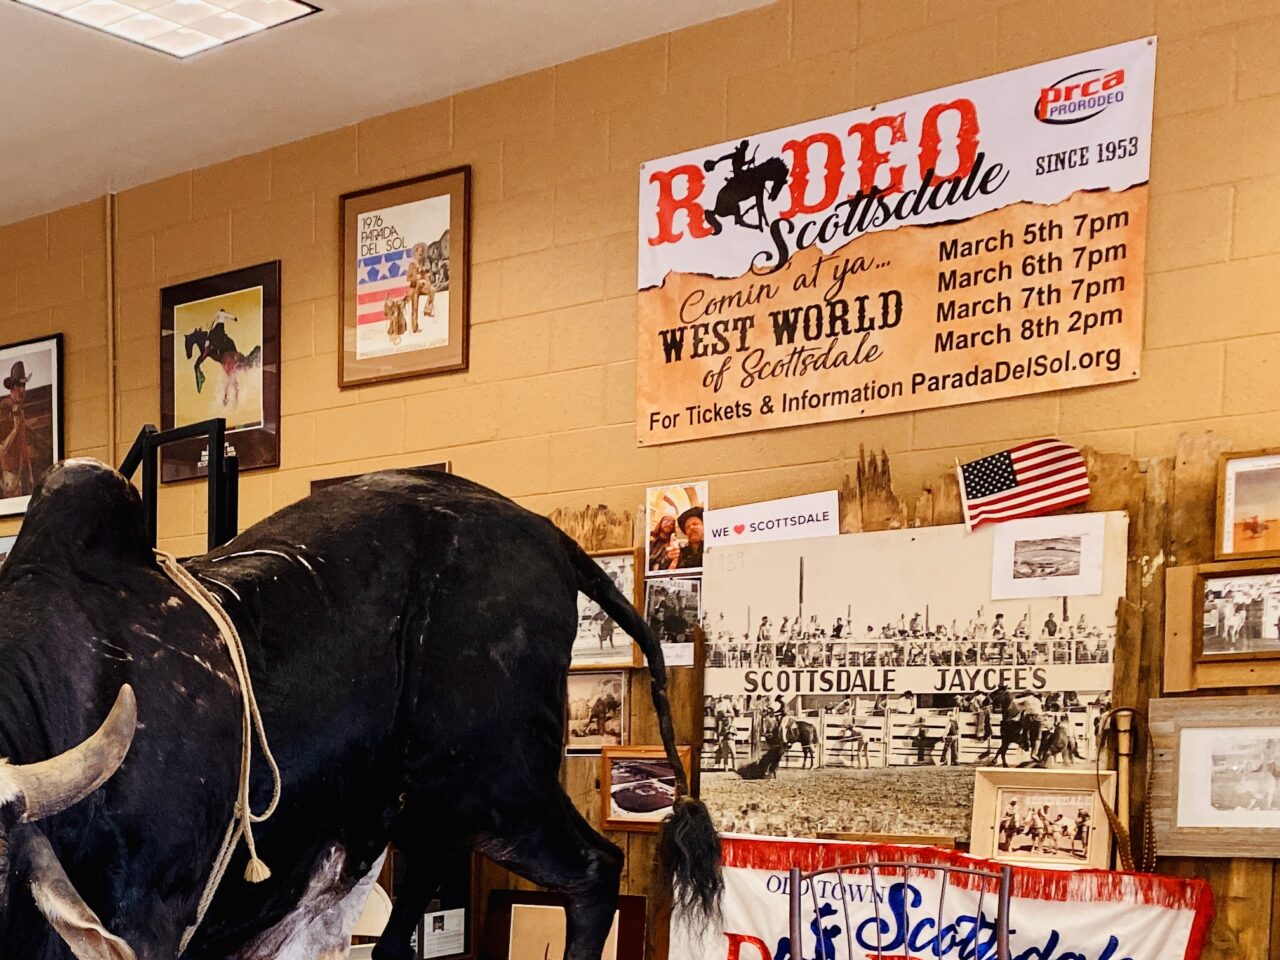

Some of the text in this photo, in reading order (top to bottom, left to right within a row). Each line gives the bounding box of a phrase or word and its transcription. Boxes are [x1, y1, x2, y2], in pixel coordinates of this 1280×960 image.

[1039, 69, 1125, 120] prca
[1049, 91, 1124, 117] PRORODEO
[647, 98, 980, 247] RDEO
[1035, 136, 1139, 176] SINCE 1953
[360, 225, 399, 243] PARADA
[362, 215, 384, 230] 1976
[750, 152, 1010, 276] Scottsdale
[939, 210, 1129, 262] March 5th 7pm
[361, 237, 408, 257] DEL SOL
[937, 242, 1127, 292] March 6th 7pm
[793, 256, 841, 289] at
[825, 257, 891, 302] ya...
[936, 275, 1125, 323] March 7th 7pm
[658, 290, 903, 364] WEST WORLD
[934, 307, 1123, 353] March 8th 2pm
[702, 332, 884, 393] of Scottsdale
[649, 348, 1122, 431] For Tickets & Information ParadaDelSol.org
[711, 511, 830, 539] WE SCOTTSDALE
[744, 666, 1047, 693] SCOTTSDALE JAYCEE'S
[766, 875, 887, 903] OLD TOWN
